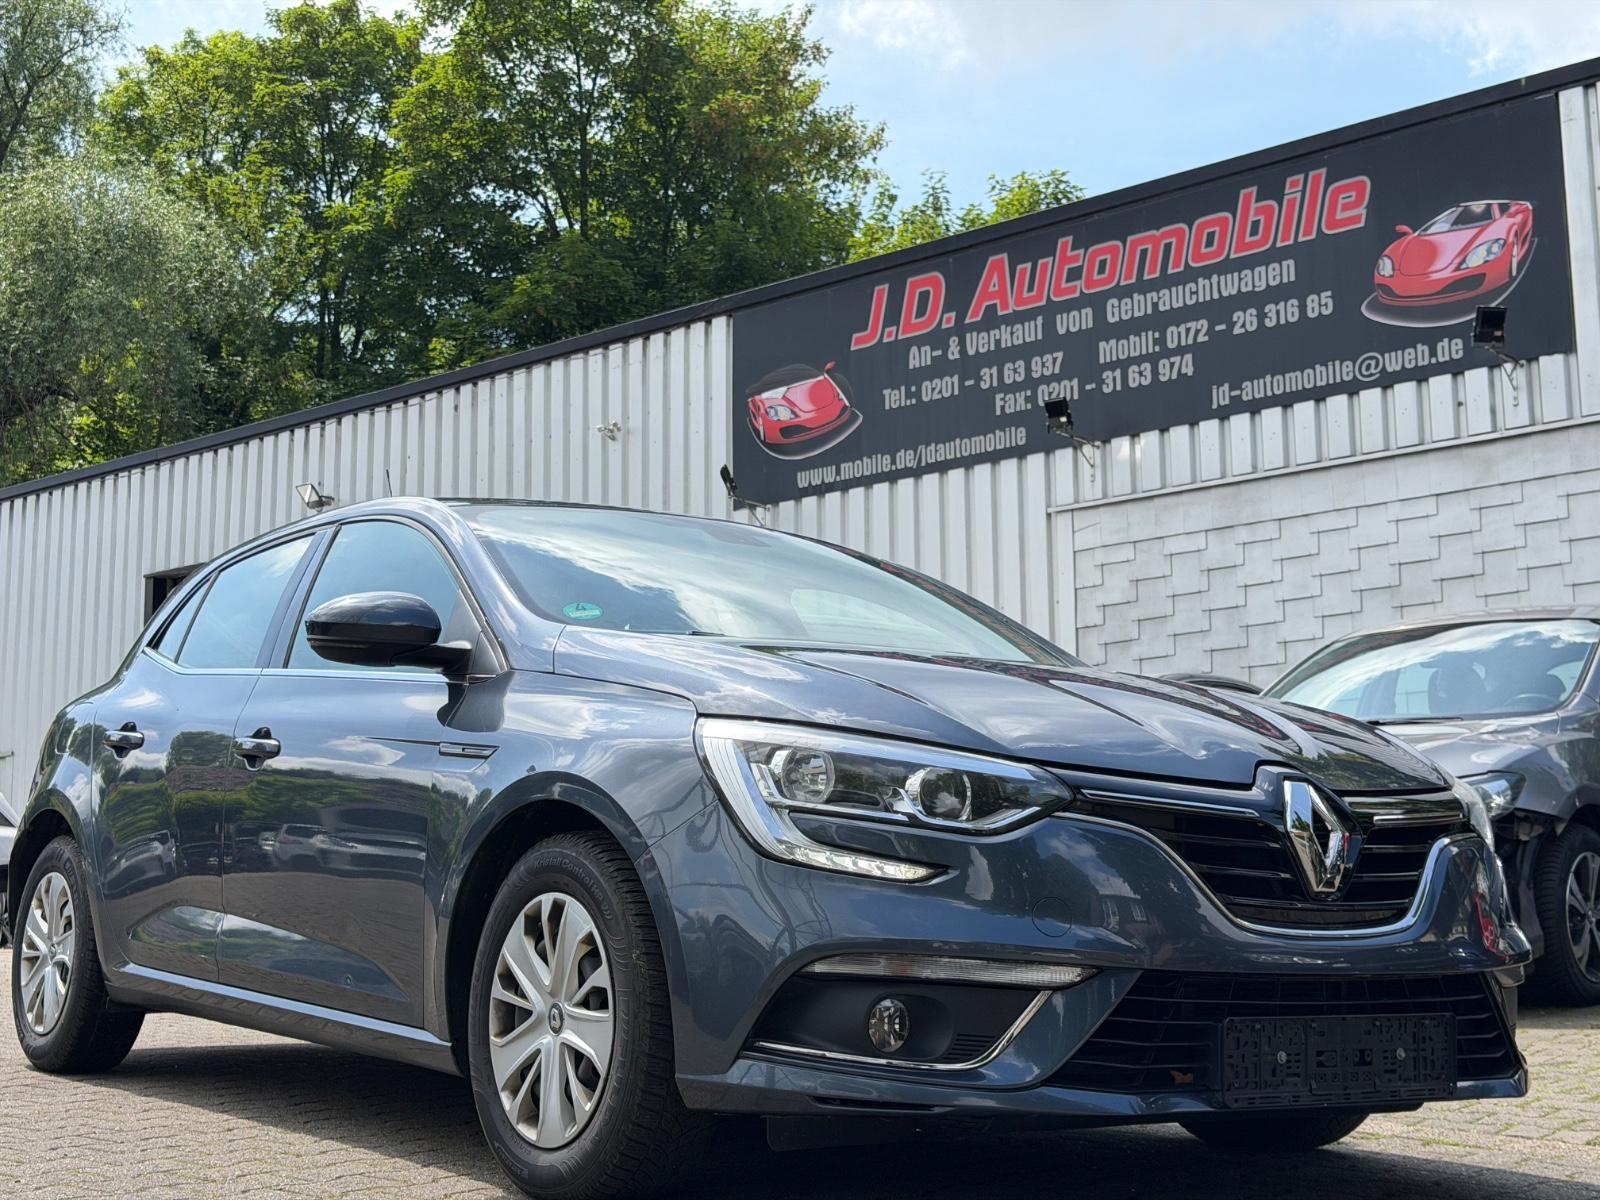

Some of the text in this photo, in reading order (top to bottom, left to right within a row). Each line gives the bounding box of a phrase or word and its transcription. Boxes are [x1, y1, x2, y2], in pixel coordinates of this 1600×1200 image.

[850, 167, 1371, 351] J.D. Automobile
[908, 258, 1296, 370] An- & Verkauf von Gebrauchtwagen
[1098, 330, 1160, 364] Mobil:
[1166, 318, 1209, 349] 0172
[1232, 307, 1258, 335] 26
[1264, 298, 1300, 328] 316
[1306, 290, 1334, 319] 85
[882, 385, 917, 410] Tel.:
[921, 374, 959, 402] 0201
[979, 365, 998, 390] 31
[1003, 359, 1026, 385] 63
[1030, 351, 1064, 379] 937
[995, 389, 1032, 416] Fax:
[1037, 377, 1079, 407] 0201
[1101, 368, 1122, 394] 31
[1127, 362, 1152, 388] 63
[1158, 353, 1194, 382] 974
[1211, 337, 1464, 410] jd-automobile@web.de
[796, 426, 1027, 489] www.mobile.de/jdautomobile
